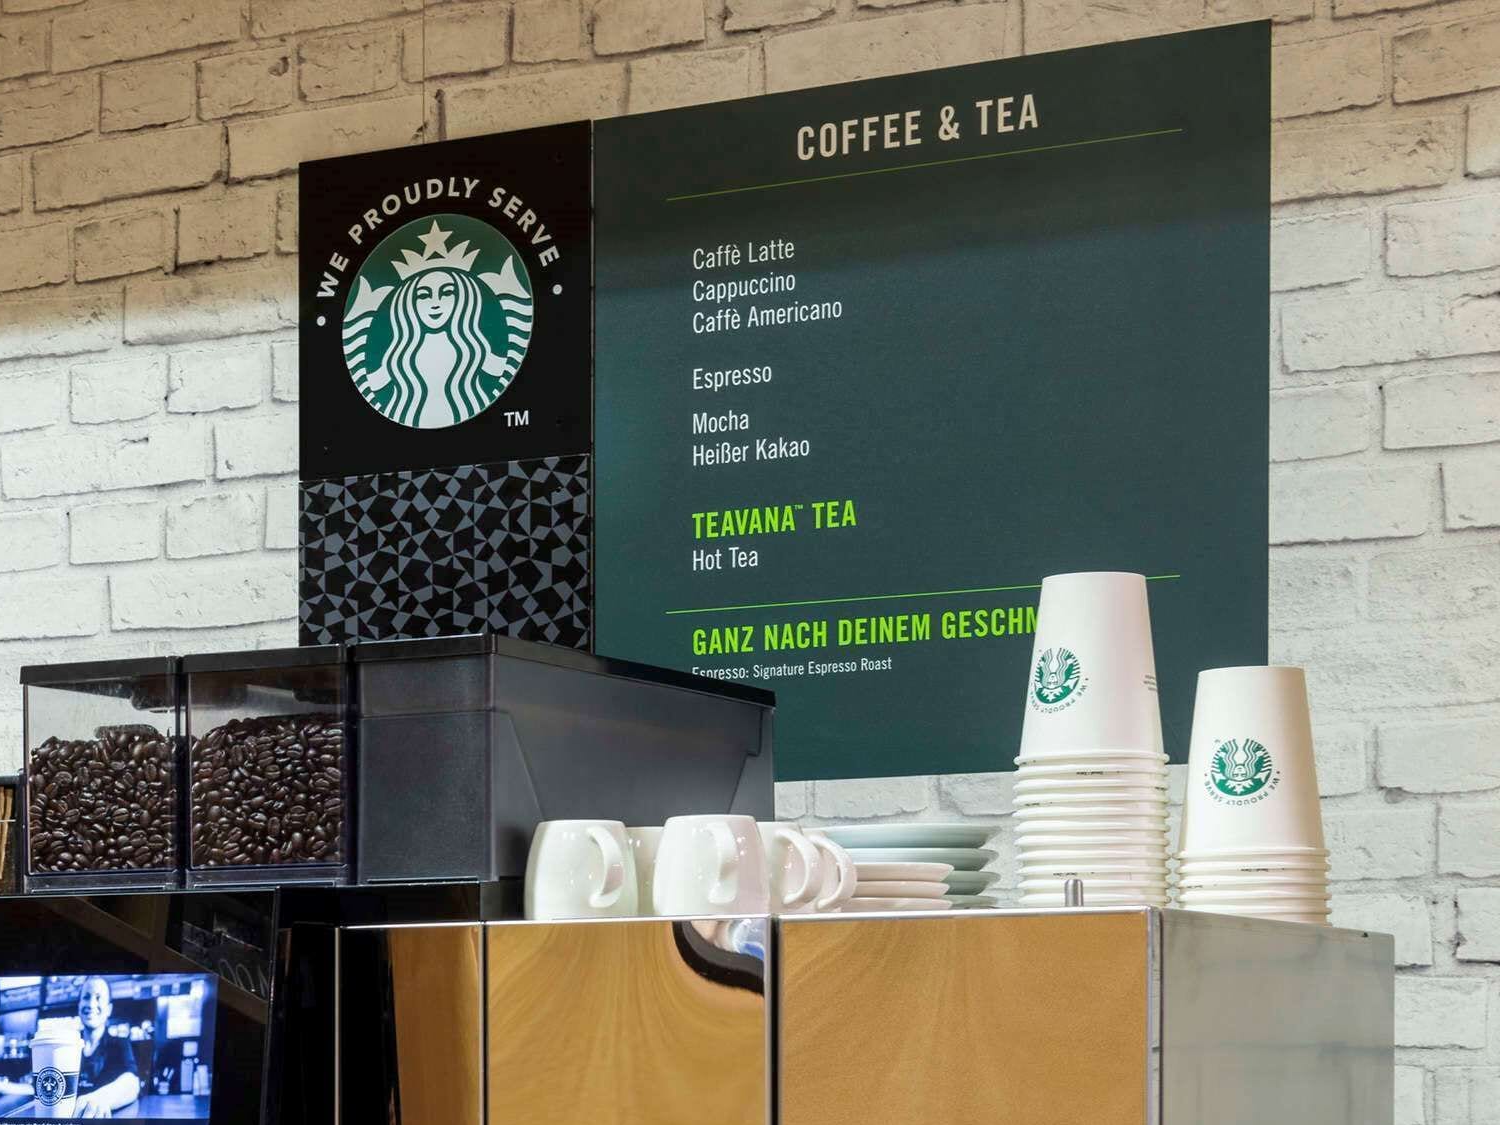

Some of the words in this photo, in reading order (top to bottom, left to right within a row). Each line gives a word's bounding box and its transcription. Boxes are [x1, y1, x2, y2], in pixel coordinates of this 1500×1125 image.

[797, 110, 922, 160] COFFEE
[938, 105, 960, 140] &
[976, 94, 1039, 136] TEA
[317, 250, 349, 299] WE
[348, 176, 480, 246] PROUDLY
[487, 186, 560, 267] SERVE
[692, 244, 741, 270] Caffè
[748, 239, 795, 263] Latte
[692, 271, 796, 303] Cappuccino
[692, 308, 741, 334] Caffè
[747, 301, 843, 328] Americano
[692, 366, 772, 392] Espresso
[504, 411, 529, 427] TM
[692, 411, 750, 435] Mocha
[692, 444, 749, 467] Heißer
[755, 438, 810, 461] Kakao
[811, 500, 858, 530] TEA
[692, 549, 722, 571] Hot
[729, 547, 759, 568] Tea
[692, 626, 755, 656] GANZ
[764, 621, 828, 651] NACH
[838, 613, 931, 647] DEINEM
[753, 662, 805, 681] Signature
[808, 660, 857, 678] Espresso
[860, 656, 892, 672] Roast
